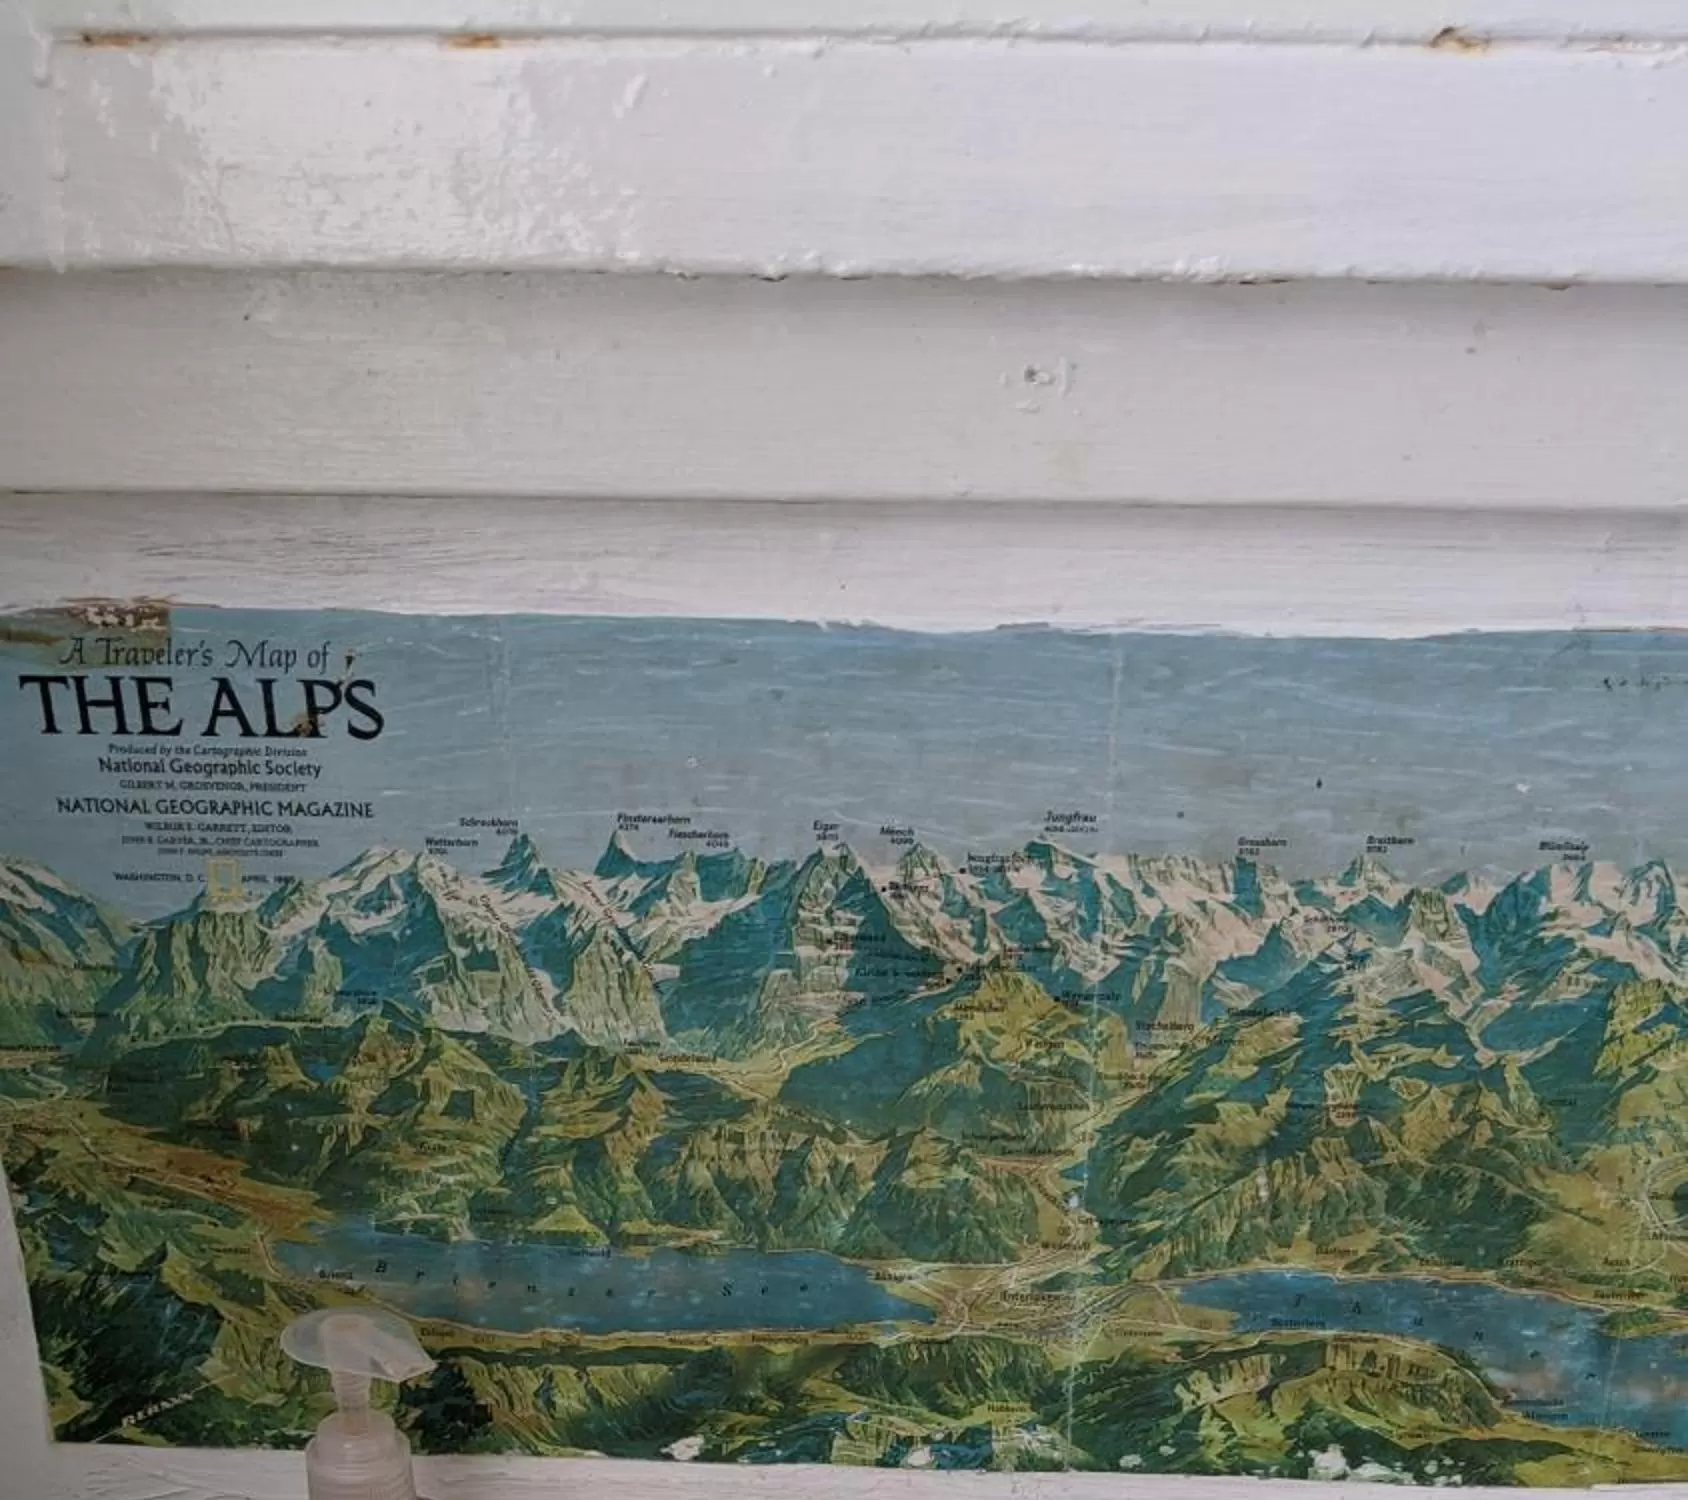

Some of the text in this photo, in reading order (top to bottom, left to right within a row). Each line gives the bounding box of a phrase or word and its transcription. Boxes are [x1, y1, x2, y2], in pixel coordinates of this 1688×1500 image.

[59, 637, 331, 675] A Traveler's Map of
[18, 674, 385, 740] THE ALPS
[108, 743, 157, 755] Produced
[160, 744, 172, 758] by
[175, 744, 191, 755] the
[98, 756, 322, 779] National Geographic Society
[56, 796, 375, 819] NATIONAL GEOGRAPHIC MAGAZINE
[1042, 810, 1098, 826] Jungfrau
